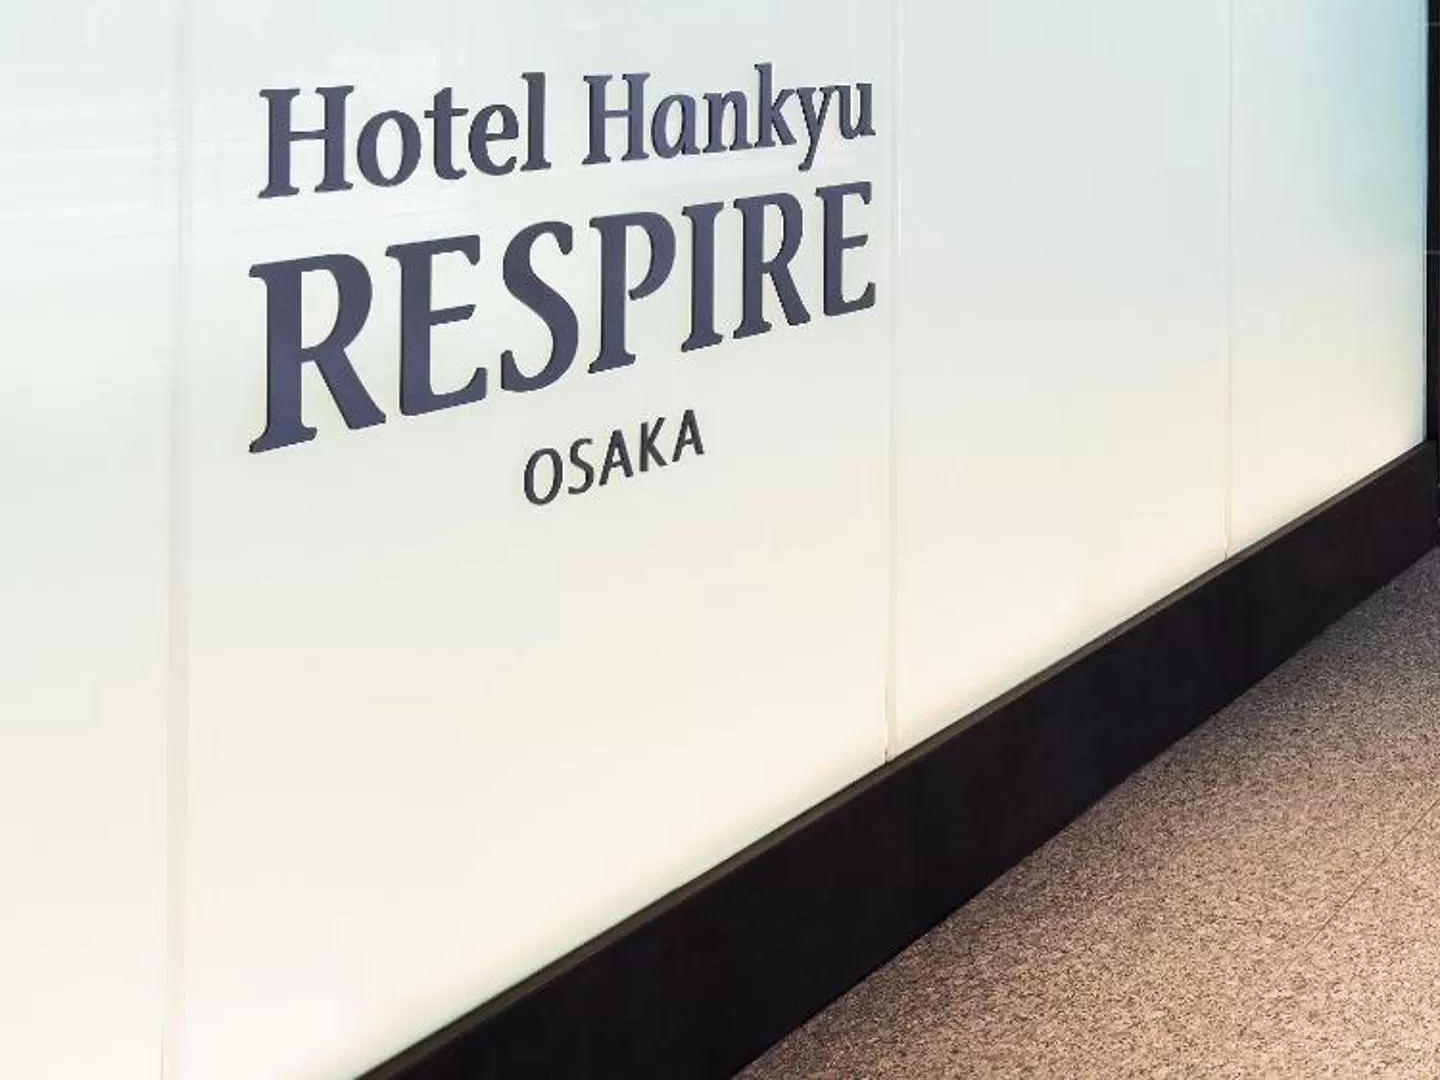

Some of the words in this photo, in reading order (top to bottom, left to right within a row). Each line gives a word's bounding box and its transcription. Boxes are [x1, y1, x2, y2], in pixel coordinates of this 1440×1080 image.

[257, 71, 552, 200] Hotel
[581, 62, 876, 172] Hankyu
[248, 181, 877, 454] RESPIRE
[522, 408, 706, 506] OSAKA
